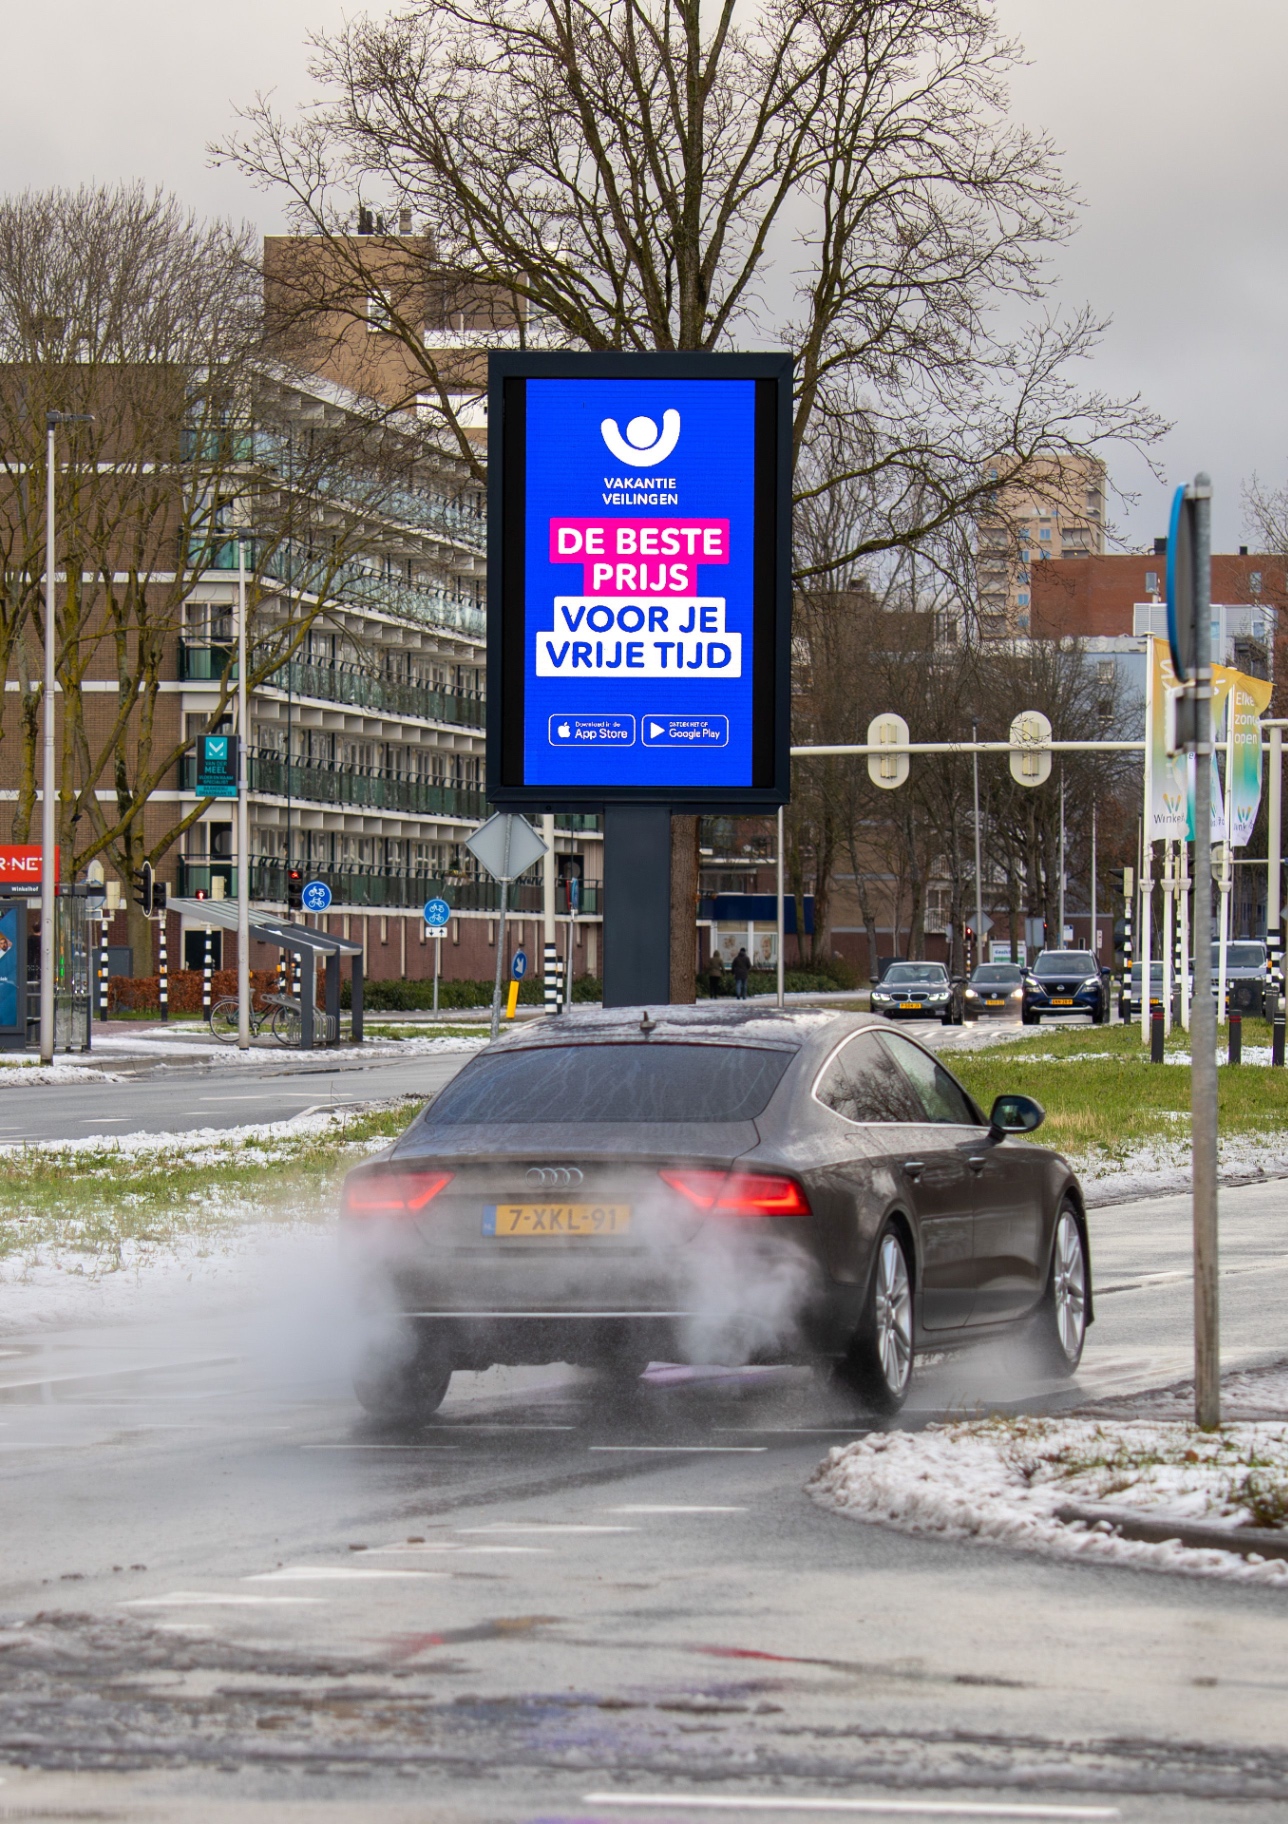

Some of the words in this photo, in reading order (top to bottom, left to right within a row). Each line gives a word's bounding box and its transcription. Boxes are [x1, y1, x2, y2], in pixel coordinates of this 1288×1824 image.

[603, 477, 677, 489] VAKANTIE
[602, 492, 678, 505] VEILINGEN
[557, 527, 605, 555] DE
[616, 527, 723, 556] BESTE
[592, 562, 689, 592] PRIJS
[560, 604, 669, 633] VOOR
[678, 605, 719, 634] JE
[545, 640, 645, 669] VRIJE
[653, 641, 732, 670] TIJD
[575, 728, 597, 740] App
[599, 728, 628, 739] Store
[669, 728, 701, 740] Google
[702, 728, 720, 740] Play
[1234, 733, 1258, 747] open
[205, 766, 227, 774] MEEL
[509, 1208, 617, 1231] 7-XKL-91
